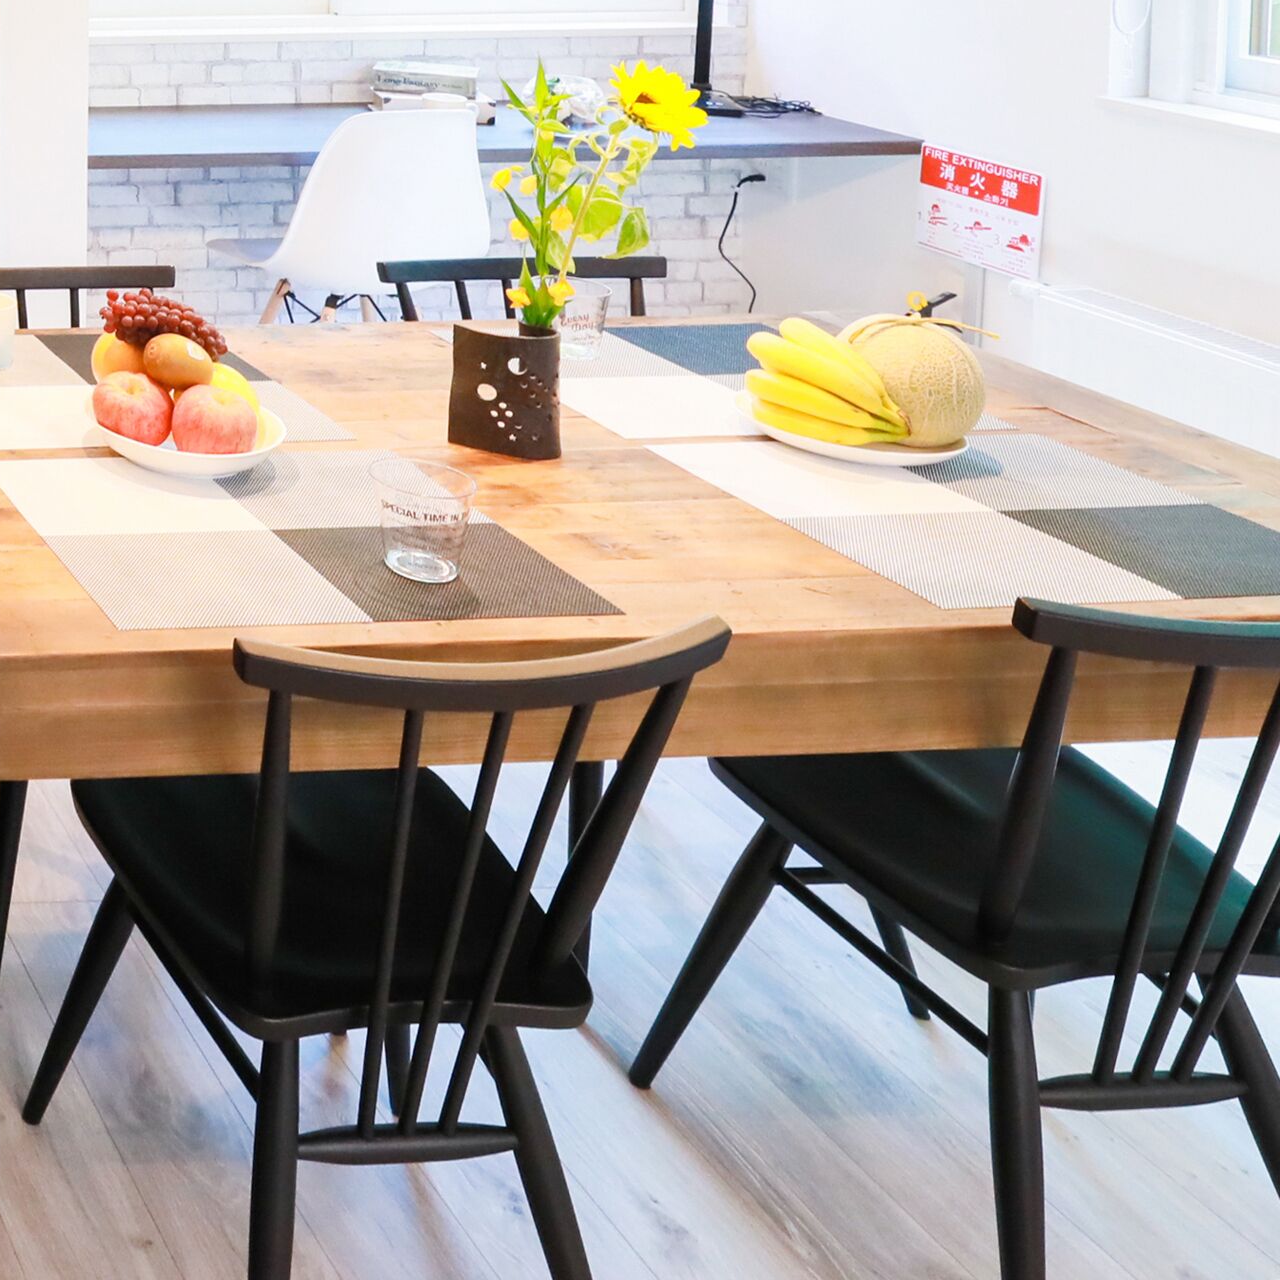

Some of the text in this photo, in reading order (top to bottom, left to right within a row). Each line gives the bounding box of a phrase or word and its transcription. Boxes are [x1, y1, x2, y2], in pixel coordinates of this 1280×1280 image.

[924, 147, 1039, 187] FIRE EXTINGUISHER
[939, 162, 1019, 200] 消火器
